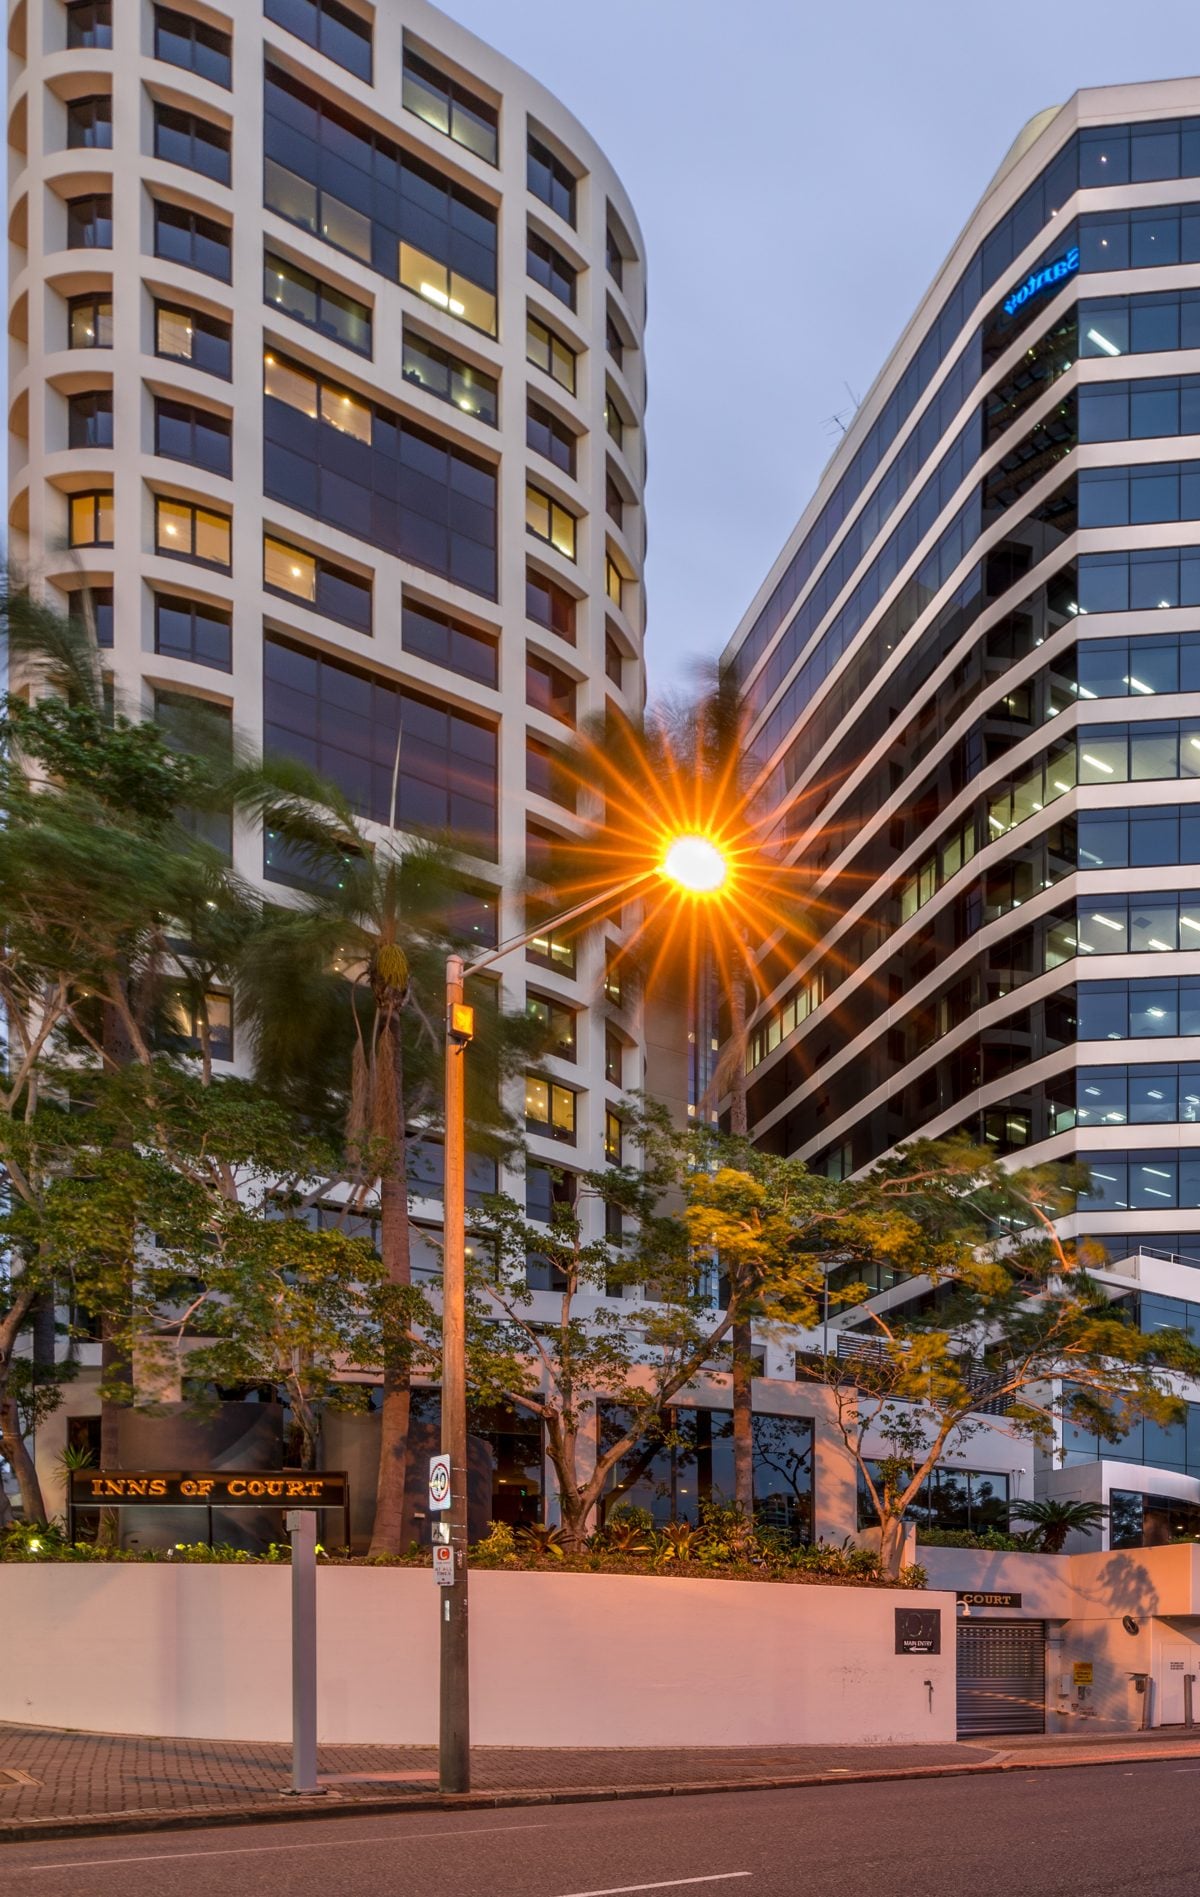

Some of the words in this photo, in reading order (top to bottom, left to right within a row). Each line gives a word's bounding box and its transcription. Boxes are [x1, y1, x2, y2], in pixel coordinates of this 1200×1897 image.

[91, 1479, 166, 1496] INNS
[180, 1480, 215, 1496] OF
[227, 1480, 324, 1497] COURT
[433, 1472, 447, 1491] 40
[963, 1594, 1011, 1605] COURT
